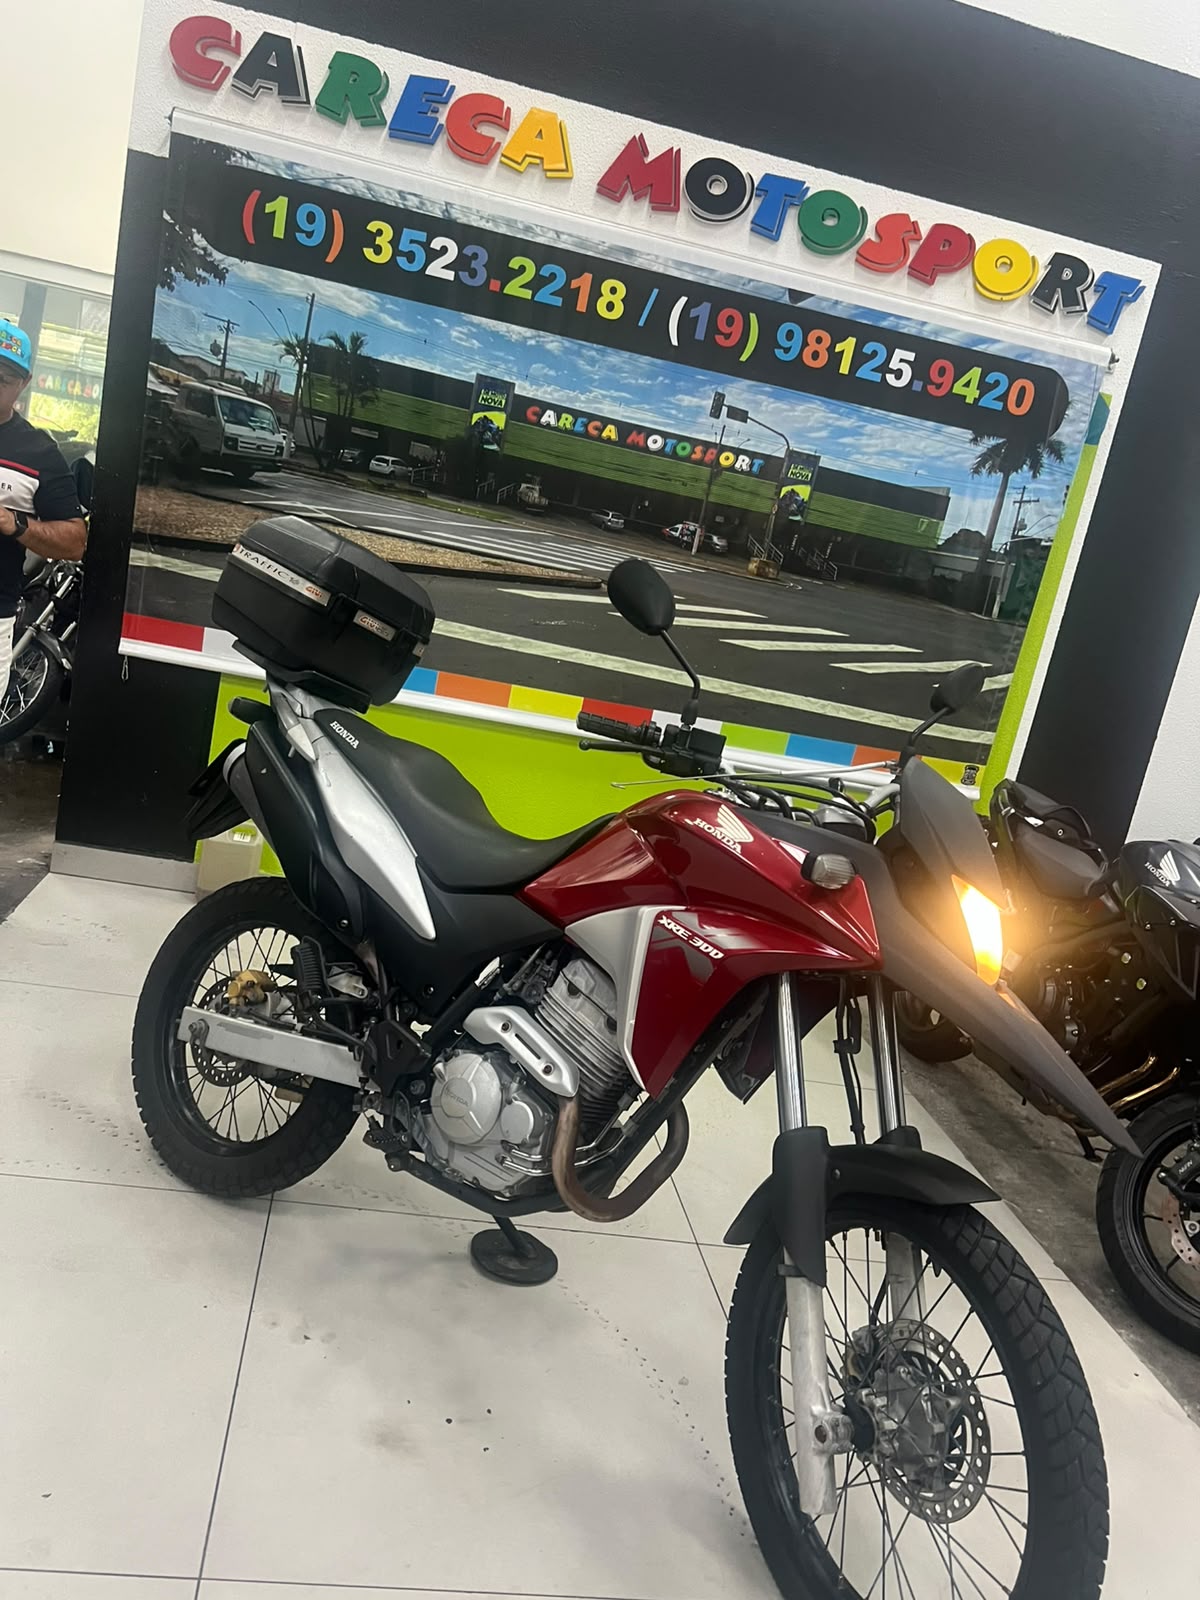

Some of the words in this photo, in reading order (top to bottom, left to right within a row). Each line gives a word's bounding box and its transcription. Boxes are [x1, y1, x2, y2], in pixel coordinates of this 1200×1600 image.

[169, 15, 573, 179] CARECA
[597, 133, 1146, 334] MOTOSPORT
[243, 190, 344, 264] (19)
[363, 221, 627, 321] 3523.2218
[638, 288, 659, 327] /
[669, 296, 760, 362] (19)
[774, 322, 1036, 416] 98125.9420
[480, 394, 504, 407] NOVA
[526, 406, 618, 441] CARECA
[626, 430, 765, 474] MOTOSPORT
[239, 548, 289, 579] TRAFFIC
[330, 720, 359, 749] HONDA
[693, 817, 742, 855] HONDA
[1144, 861, 1170, 887] HONDA
[658, 915, 692, 941] XRE
[689, 936, 724, 959] 300
